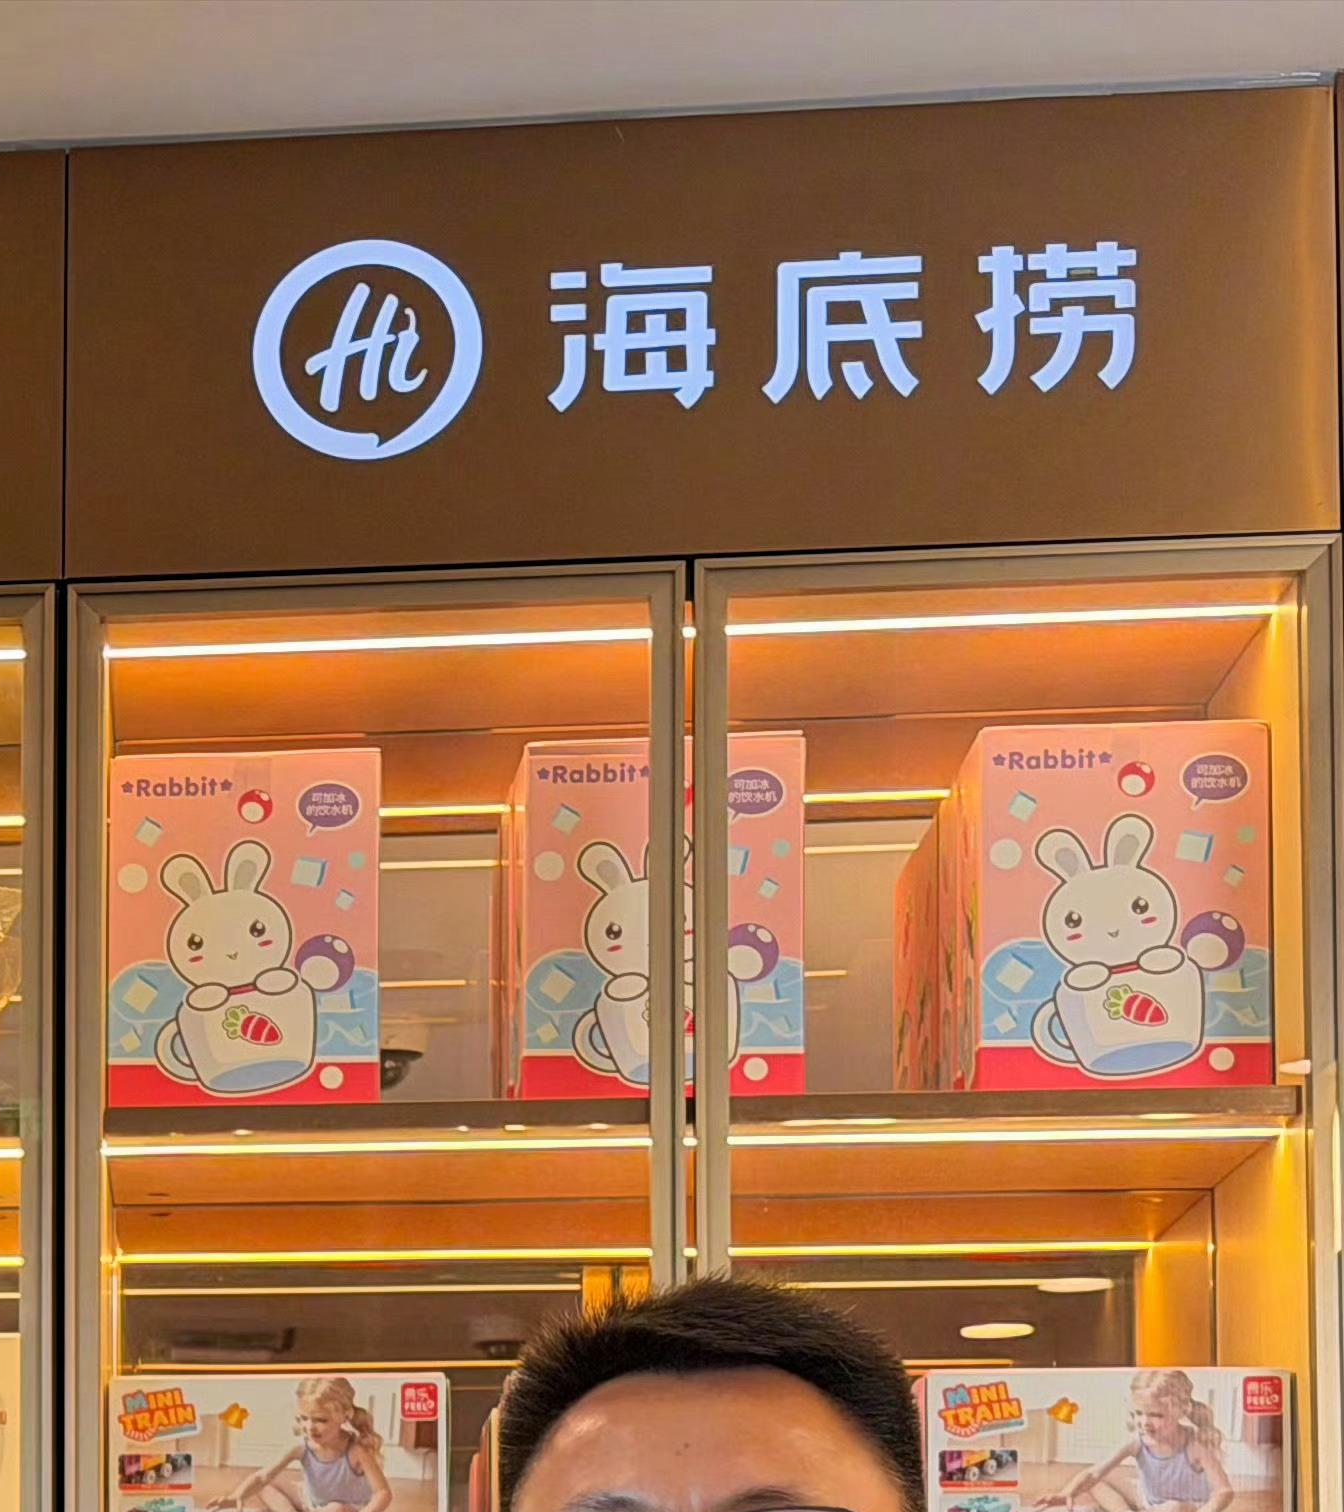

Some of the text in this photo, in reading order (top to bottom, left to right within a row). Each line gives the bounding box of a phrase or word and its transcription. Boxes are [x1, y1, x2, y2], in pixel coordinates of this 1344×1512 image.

[547, 240, 1138, 413] 海底捞
[1008, 748, 1096, 770] Rabbit
[136, 776, 218, 797] Rabbit
[552, 763, 637, 784] Rabbit
[123, 1388, 183, 1415] MINI
[944, 1383, 1008, 1409] MINI
[119, 1405, 195, 1434] TRAIN
[939, 1399, 1021, 1430] TRAIN
